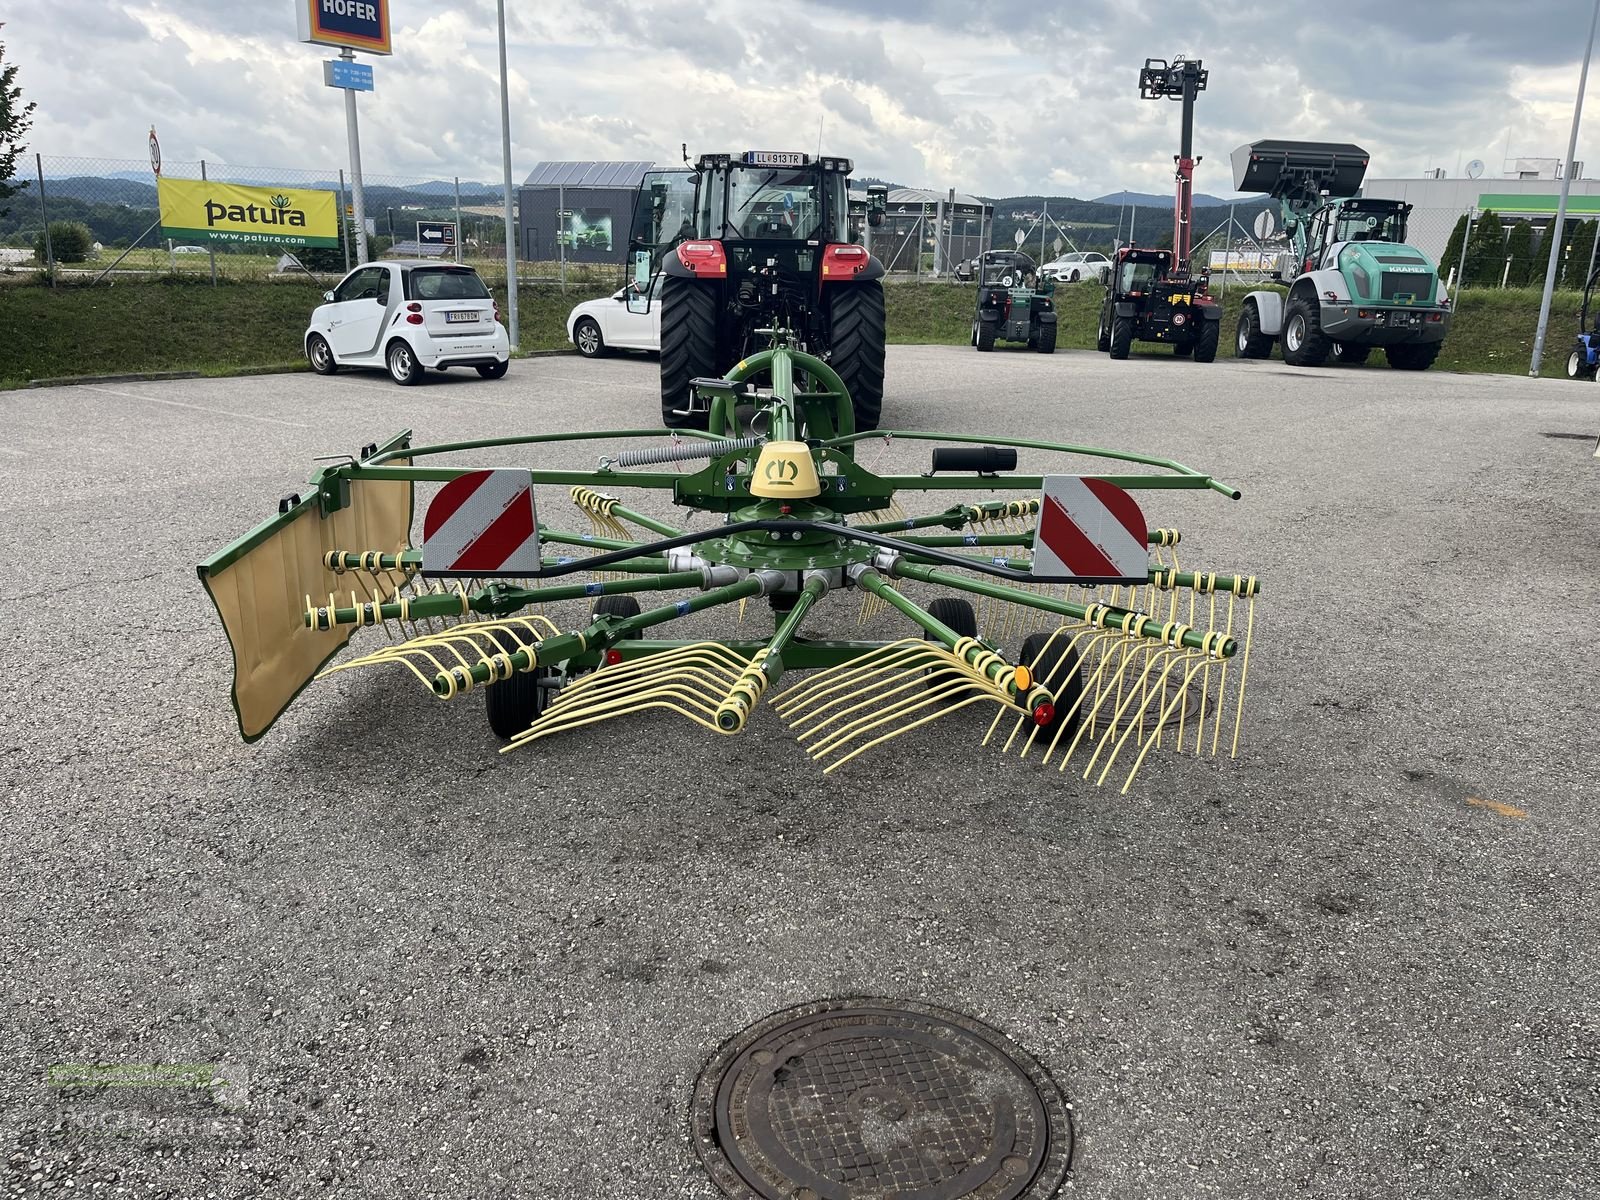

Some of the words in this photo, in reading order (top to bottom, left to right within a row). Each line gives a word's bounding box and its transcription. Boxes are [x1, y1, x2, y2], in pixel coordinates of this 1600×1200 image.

[323, 0, 377, 21] HOFER
[757, 154, 766, 163] LL
[773, 154, 787, 163] 913
[789, 155, 799, 164] TR
[204, 199, 306, 227] patura
[208, 232, 306, 244] www.patura.com
